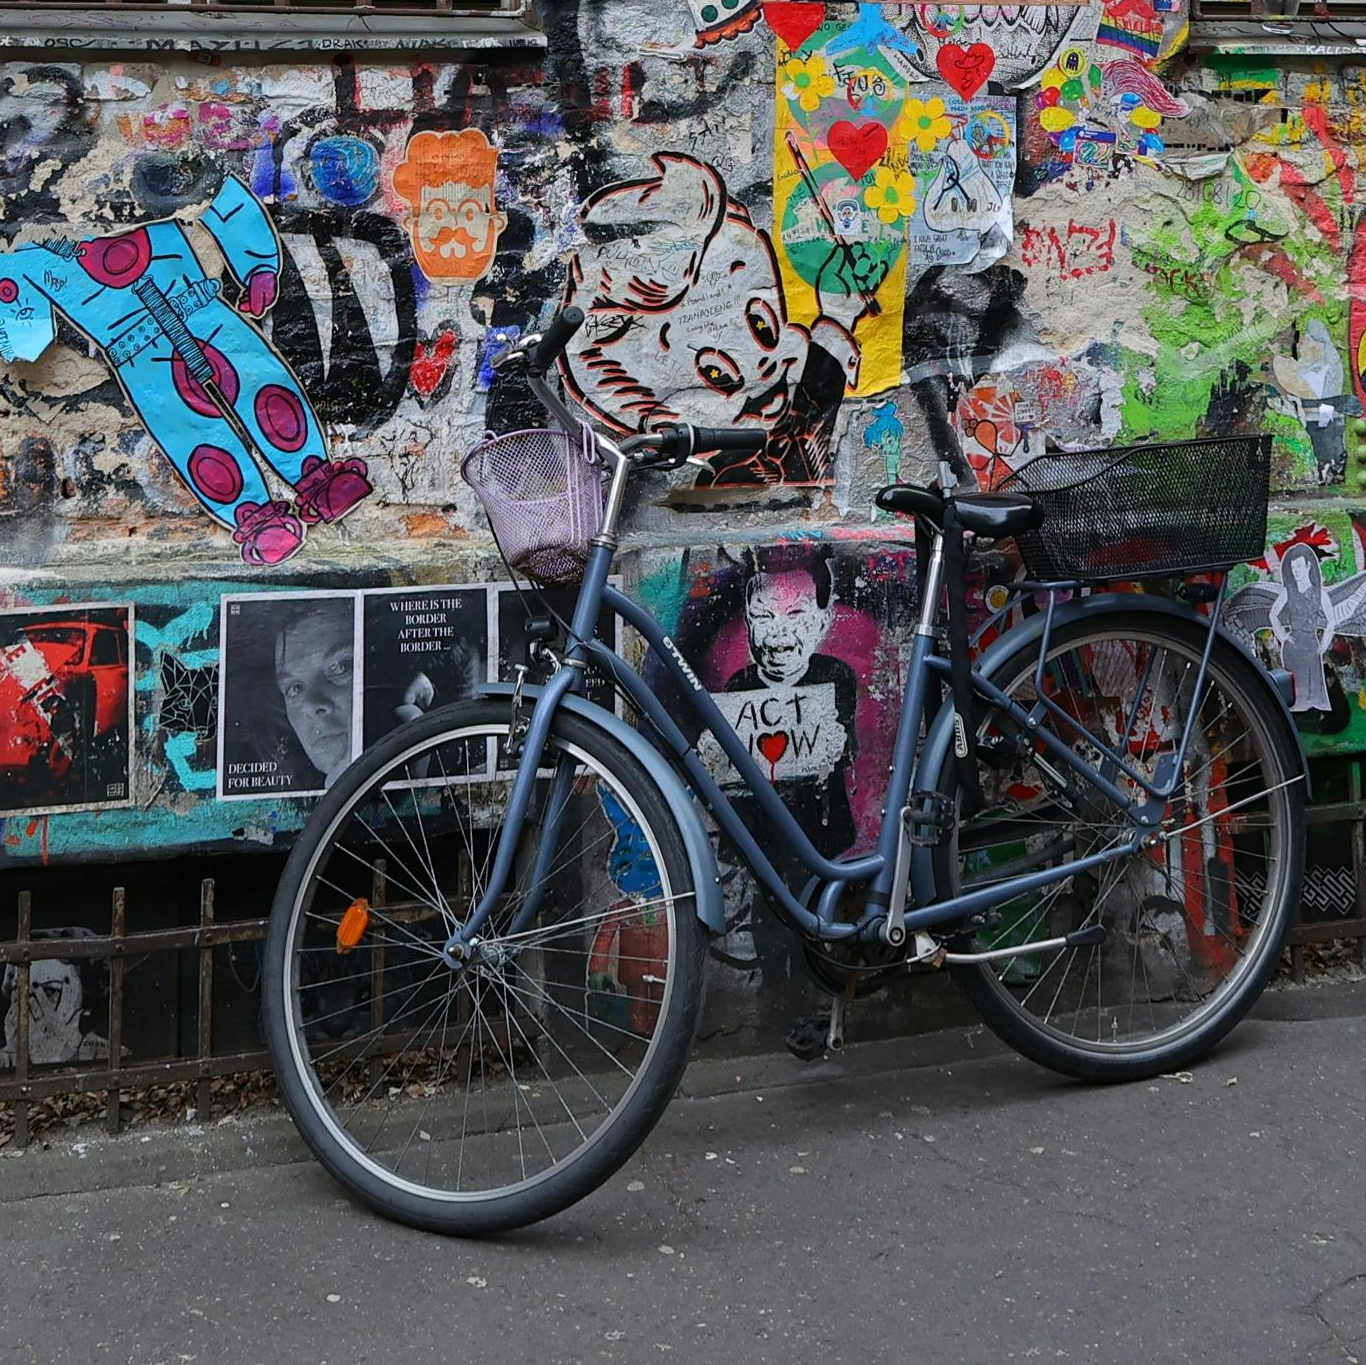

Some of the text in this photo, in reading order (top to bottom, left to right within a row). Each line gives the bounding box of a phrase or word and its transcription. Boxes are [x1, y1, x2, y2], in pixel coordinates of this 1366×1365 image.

[389, 597, 463, 613] WHERE THE
[404, 613, 447, 626] BORDER
[397, 626, 455, 641] AFTER THE
[399, 640, 440, 654] BORDER
[734, 692, 808, 731] ACT
[228, 761, 278, 775] DECIDED
[228, 774, 293, 790] FOR BEAUTY
